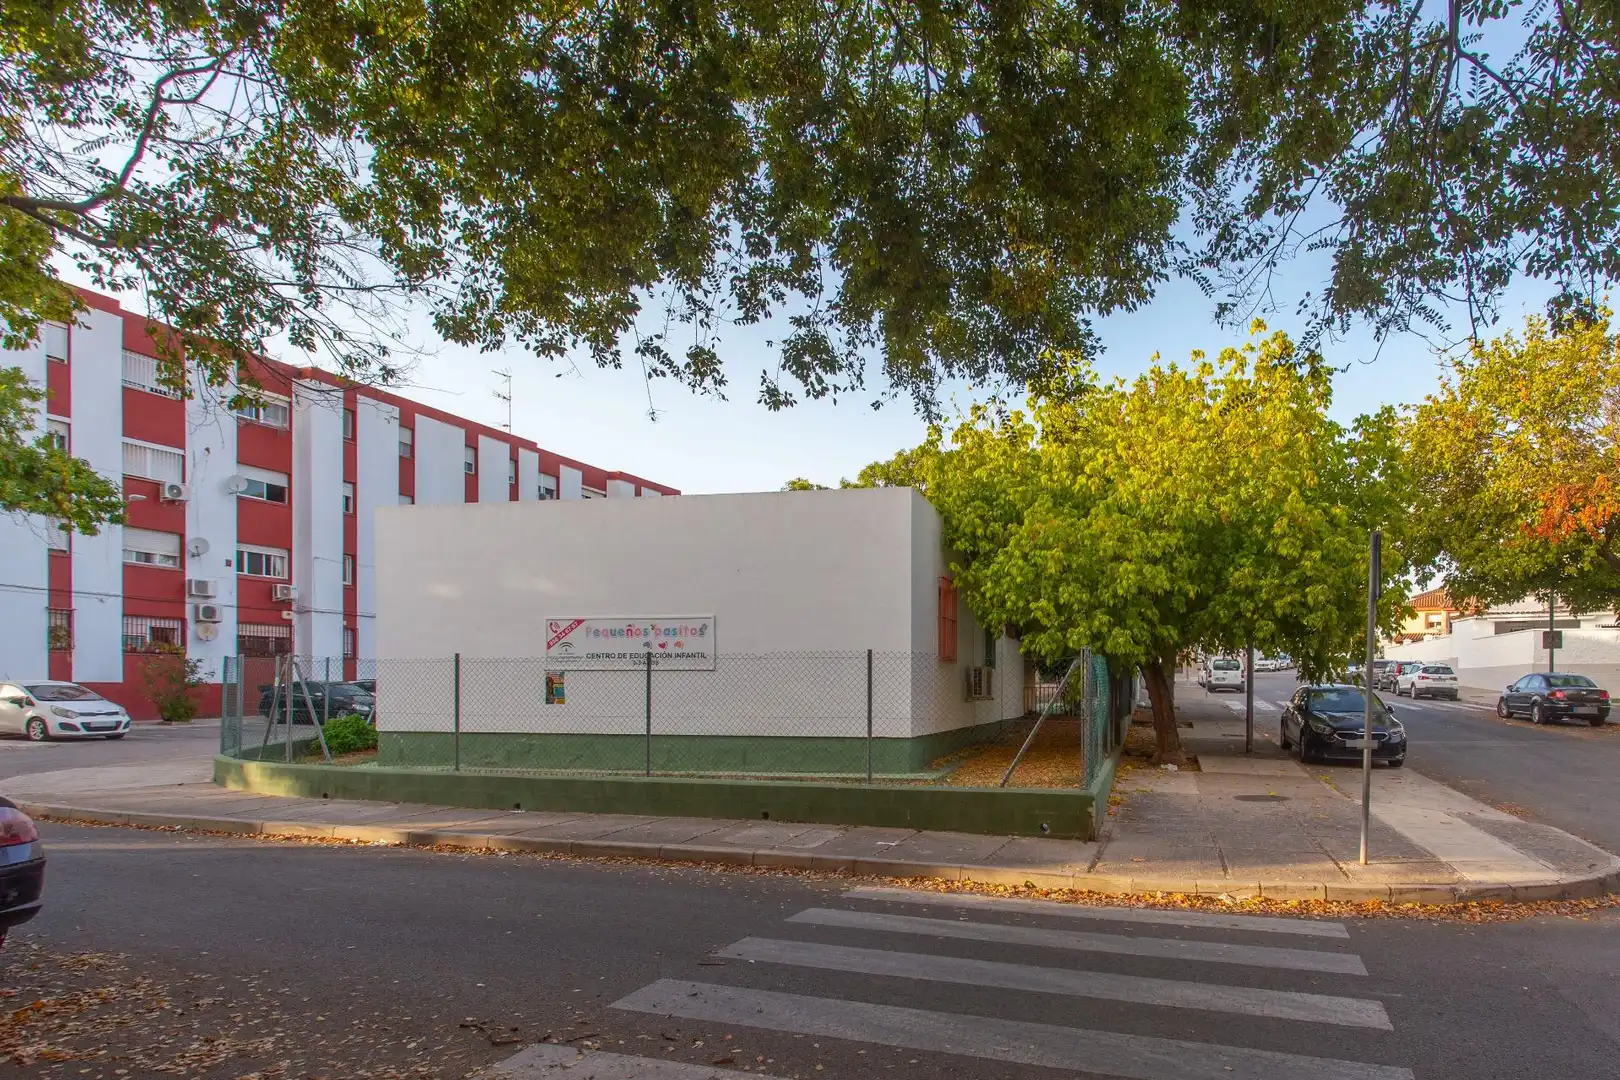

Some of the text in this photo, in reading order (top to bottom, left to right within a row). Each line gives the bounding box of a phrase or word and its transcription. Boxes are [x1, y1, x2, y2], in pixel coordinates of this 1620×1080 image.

[585, 624, 707, 639] Pequeños pasitos
[586, 652, 616, 660] CENTRO
[618, 652, 628, 660] DE
[674, 651, 707, 659] INFANTIL
